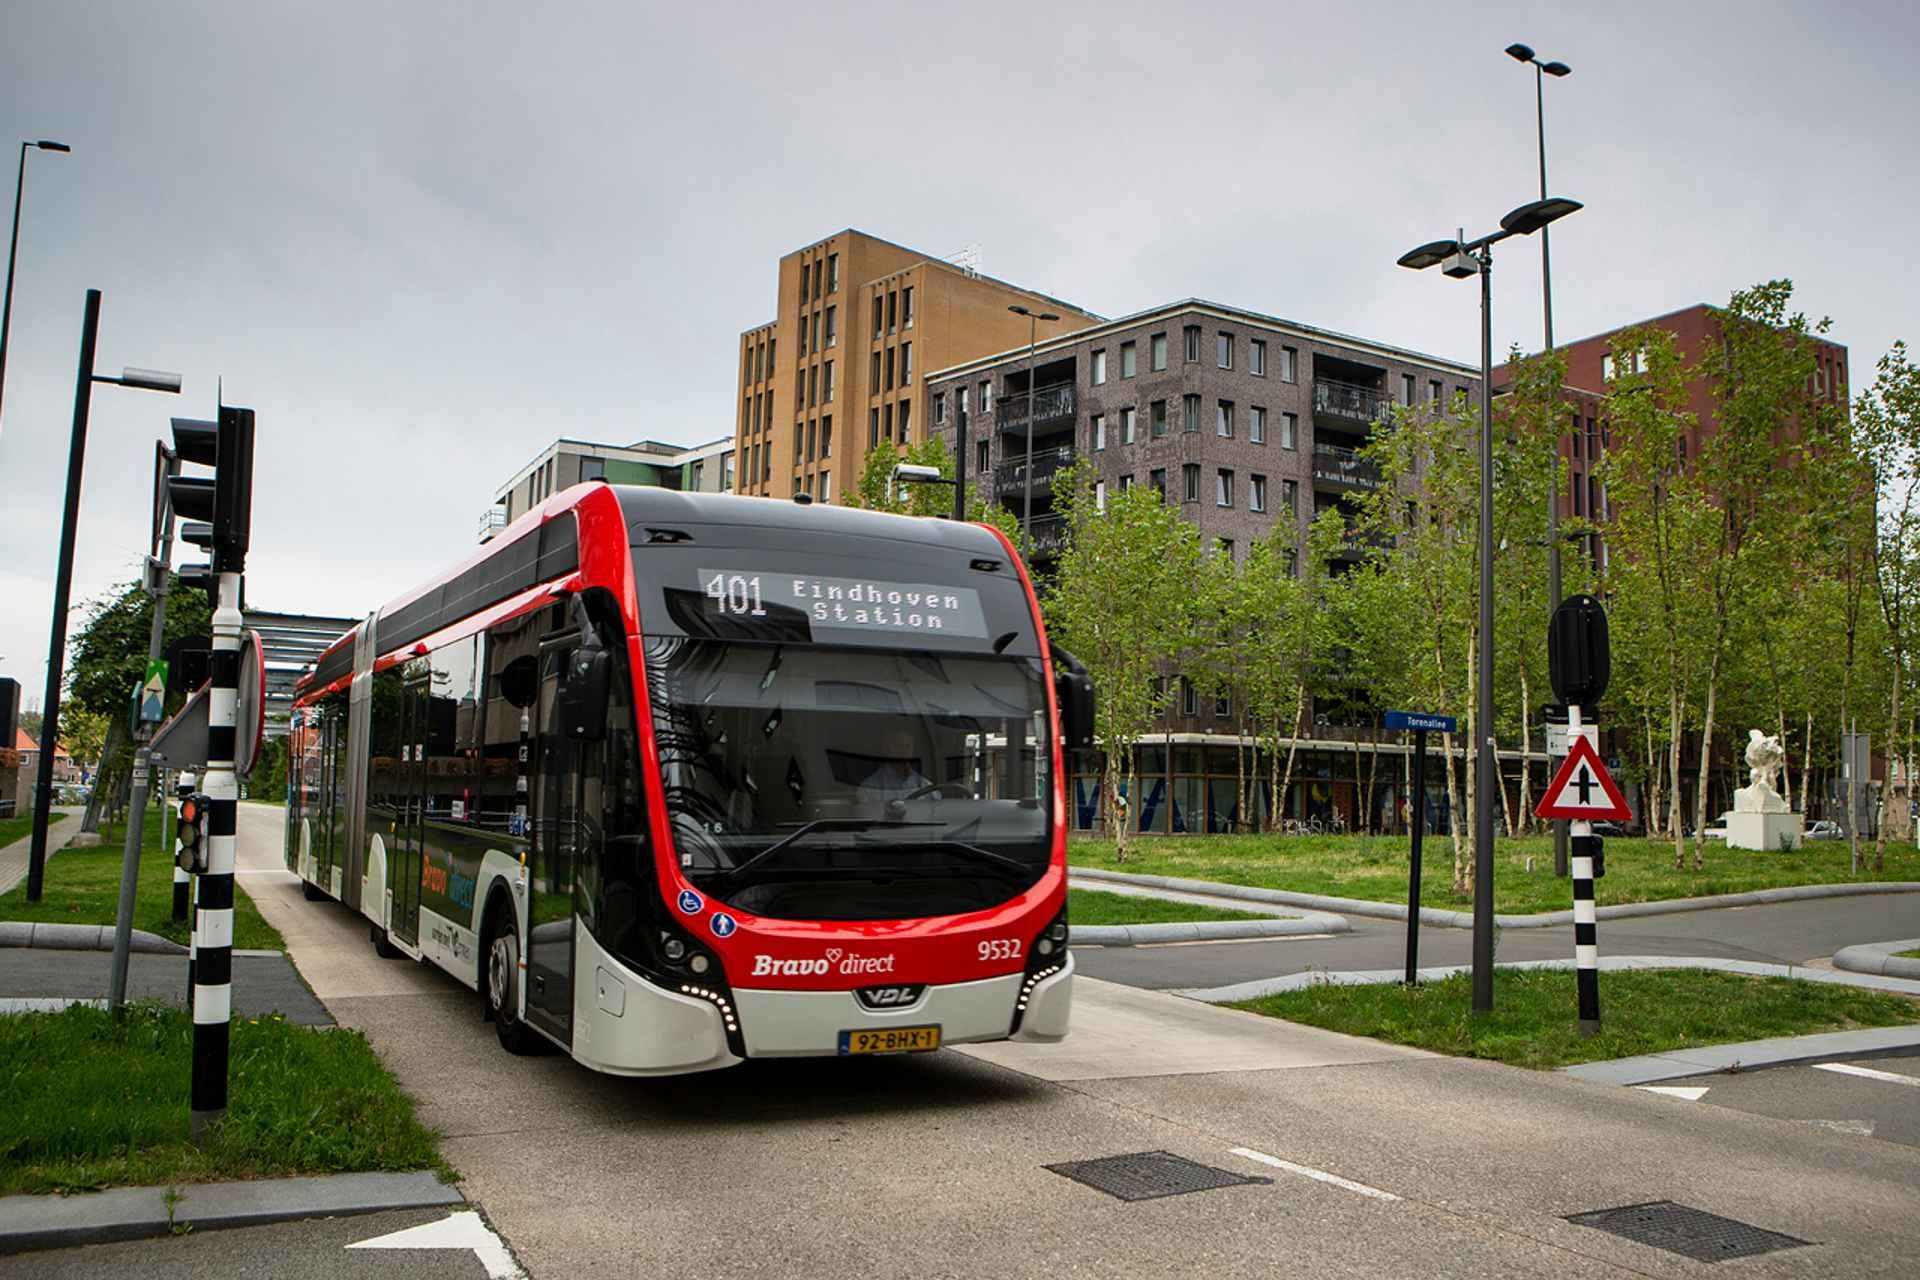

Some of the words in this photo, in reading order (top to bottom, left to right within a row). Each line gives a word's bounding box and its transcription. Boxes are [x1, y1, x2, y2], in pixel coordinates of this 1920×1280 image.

[705, 574, 767, 616] 401
[793, 579, 960, 610] Eindhoven
[813, 603, 942, 629] Station
[977, 938, 1021, 961] 9532
[751, 954, 829, 976] Bravo
[839, 952, 895, 975] direct
[865, 987, 915, 1004] VDL
[858, 1031, 932, 1050] 92-BHX-1
